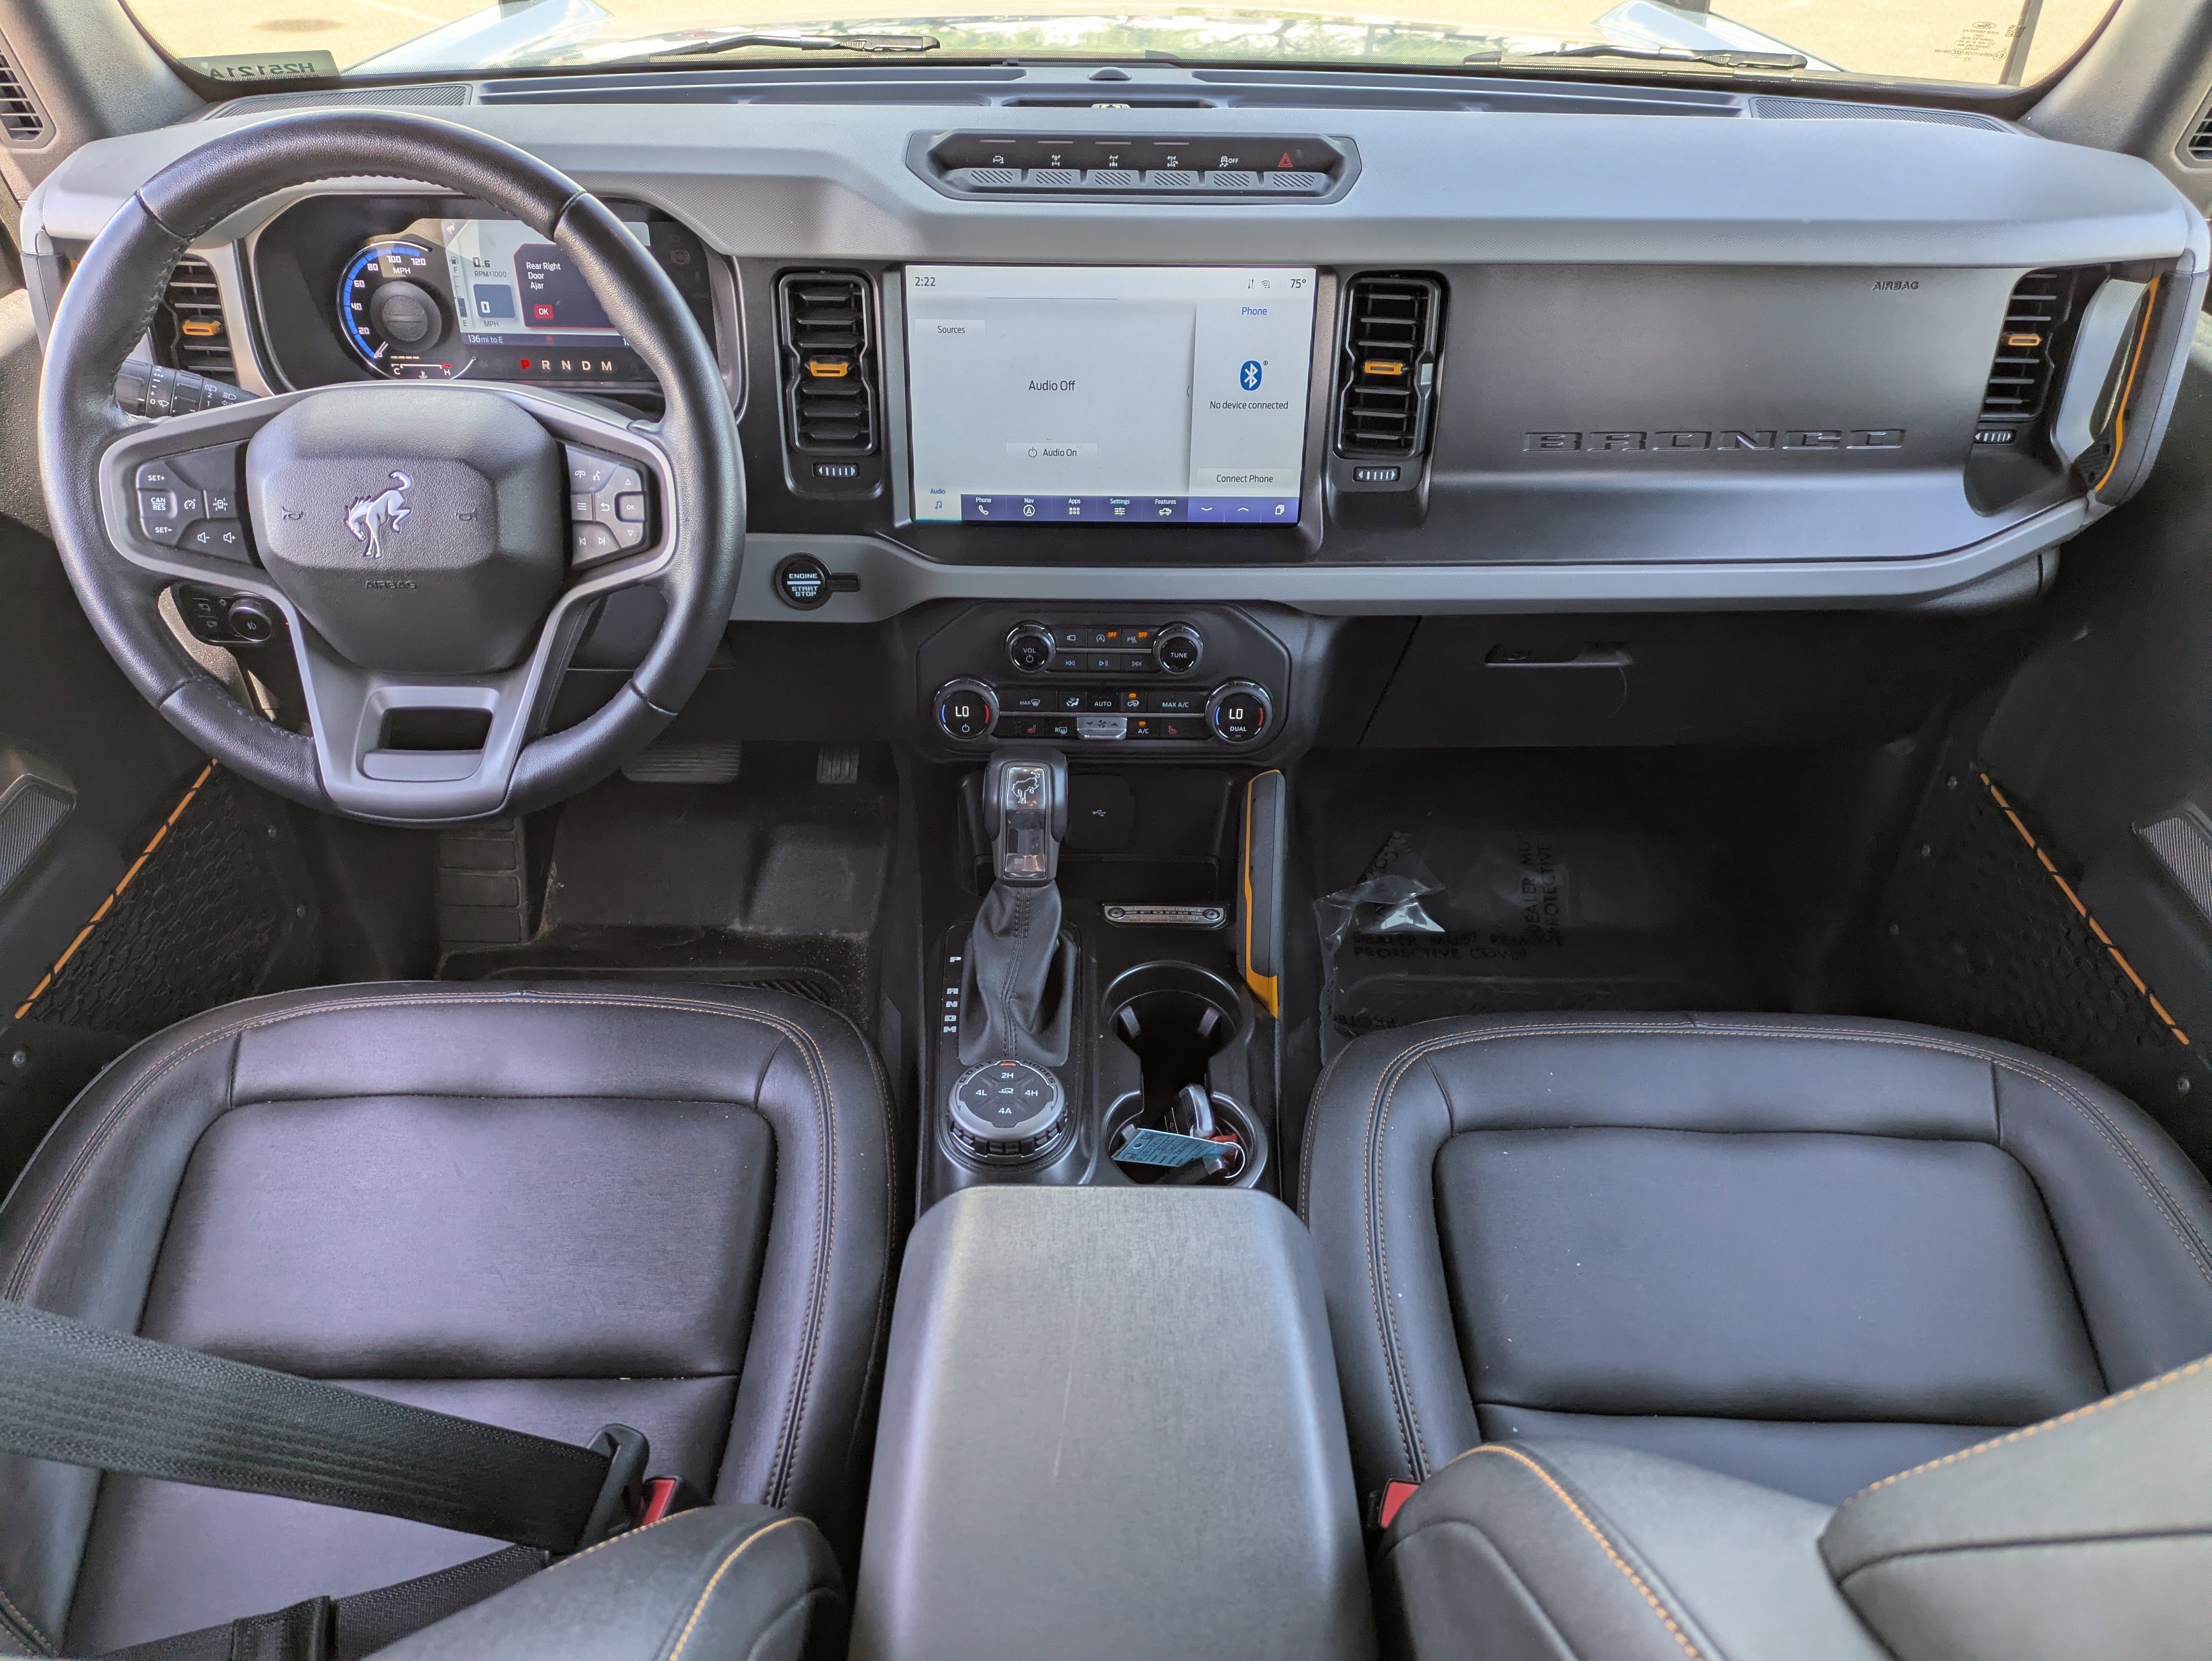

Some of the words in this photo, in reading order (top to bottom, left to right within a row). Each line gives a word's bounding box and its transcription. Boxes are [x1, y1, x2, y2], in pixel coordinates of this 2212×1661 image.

[543, 262, 561, 271] Right
[530, 281, 544, 290] Ajar
[915, 276, 936, 287] 2:22
[1872, 281, 1919, 290] AIRBAG
[481, 300, 490, 313] 0
[1241, 307, 1267, 316] Phone
[937, 325, 965, 334] Sources
[520, 359, 530, 369] P
[542, 361, 550, 370] R
[562, 361, 571, 370] N
[582, 361, 591, 370] D
[602, 362, 612, 371] M
[1029, 380, 1058, 391] Audio
[1060, 380, 1076, 391] Off
[1210, 401, 1220, 409] No
[1222, 401, 1247, 410] device
[1248, 401, 1289, 410] connected
[1523, 429, 1906, 452] BRONCO
[1043, 448, 1064, 456] Audio
[1217, 474, 1247, 483] Connect
[1249, 475, 1273, 483] Phone
[955, 706, 969, 717] LO
[1229, 709, 1243, 720] LO
[1023, 1060, 1056, 1084] MODES
